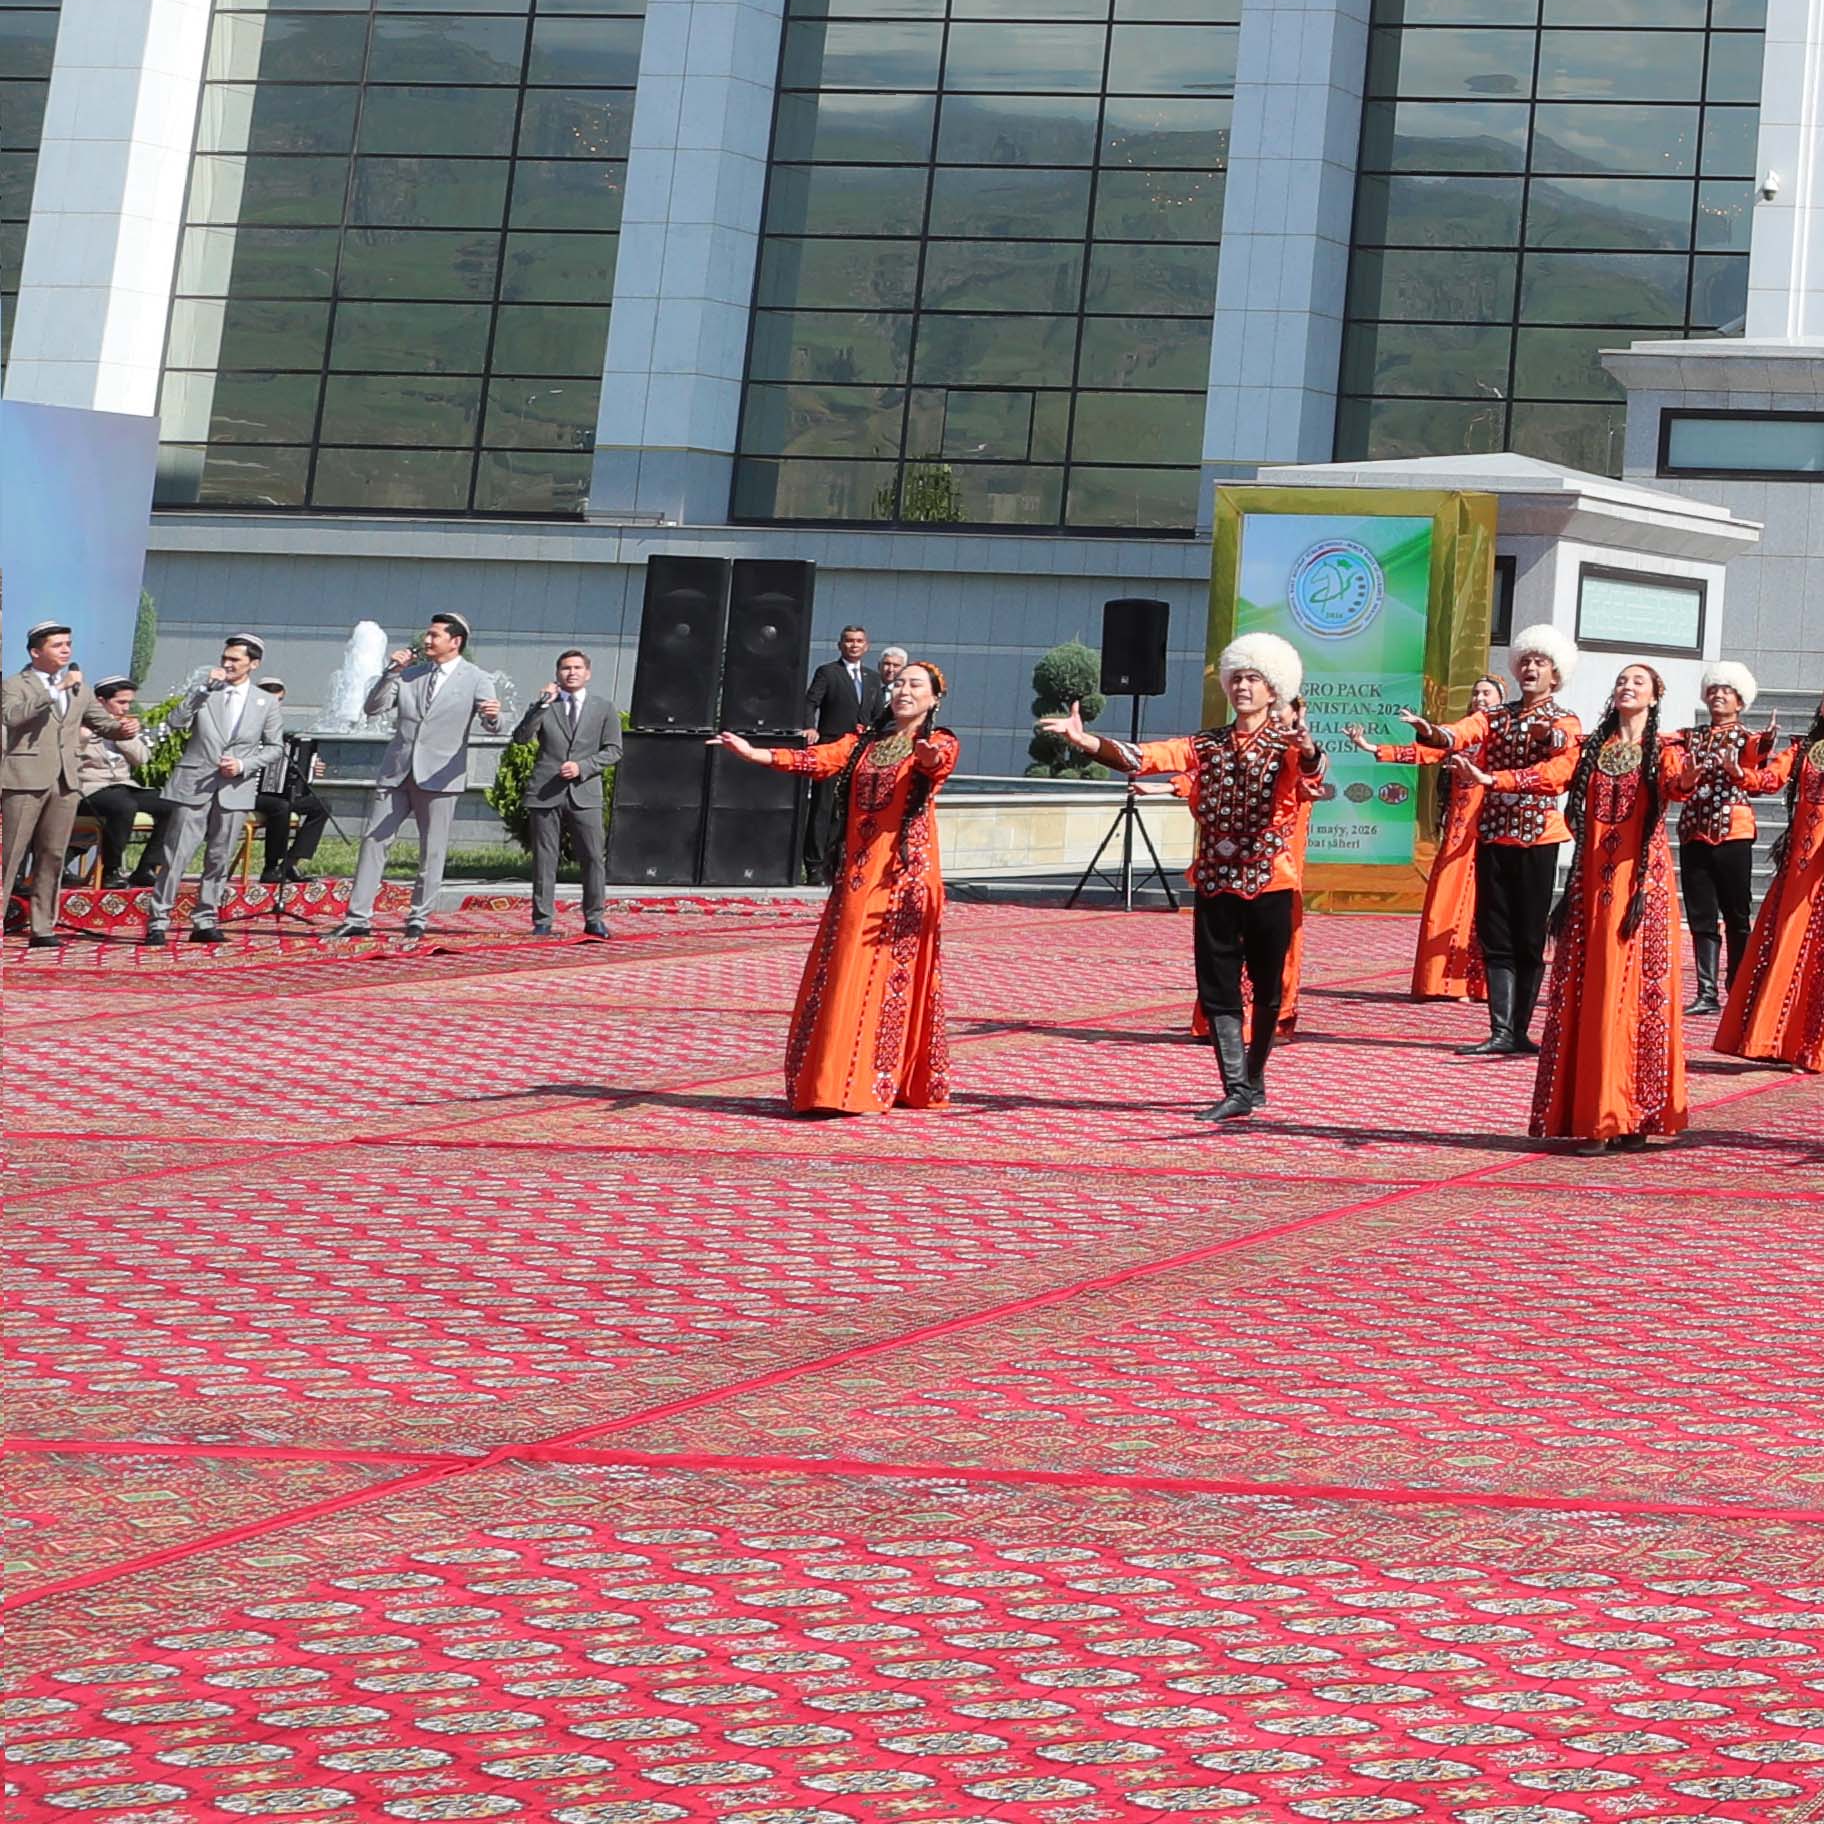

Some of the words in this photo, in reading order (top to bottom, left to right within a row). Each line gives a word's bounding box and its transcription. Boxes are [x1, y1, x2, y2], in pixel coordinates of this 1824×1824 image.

[1301, 682, 1334, 697] GRO
[1337, 683, 1383, 698] PACK
[1351, 824, 1377, 836] 2026
